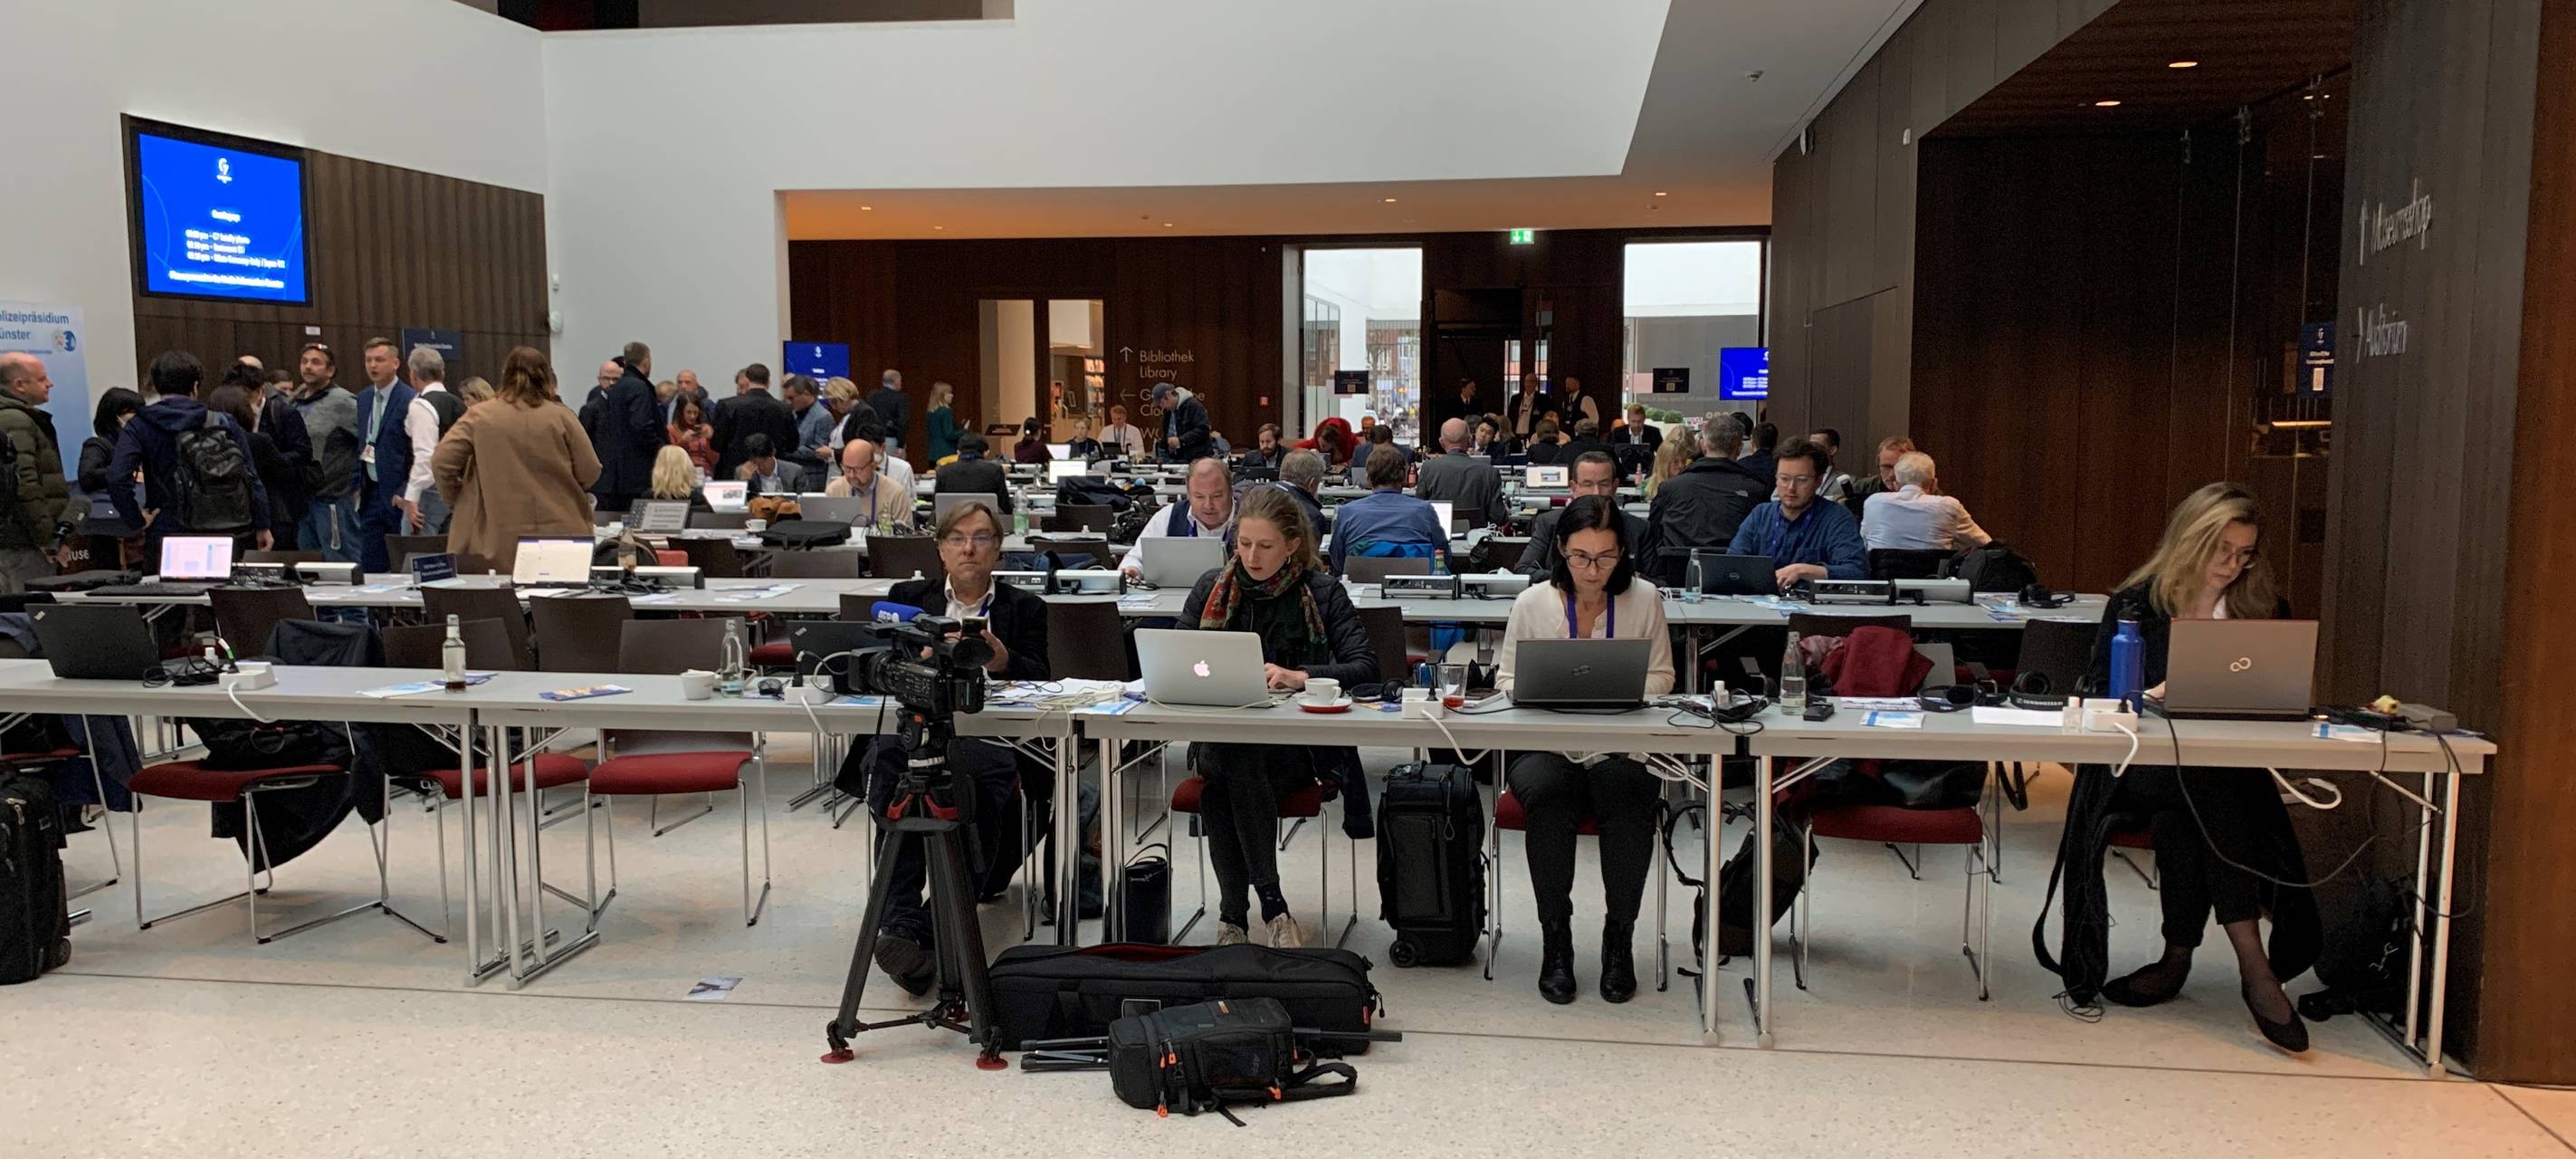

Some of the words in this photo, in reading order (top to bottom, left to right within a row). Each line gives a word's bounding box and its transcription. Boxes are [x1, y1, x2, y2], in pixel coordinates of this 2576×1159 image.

[0, 310, 70, 324] lizeipräsidium
[1140, 349, 1195, 363] Bibliothek
[1140, 365, 1178, 381] Library
